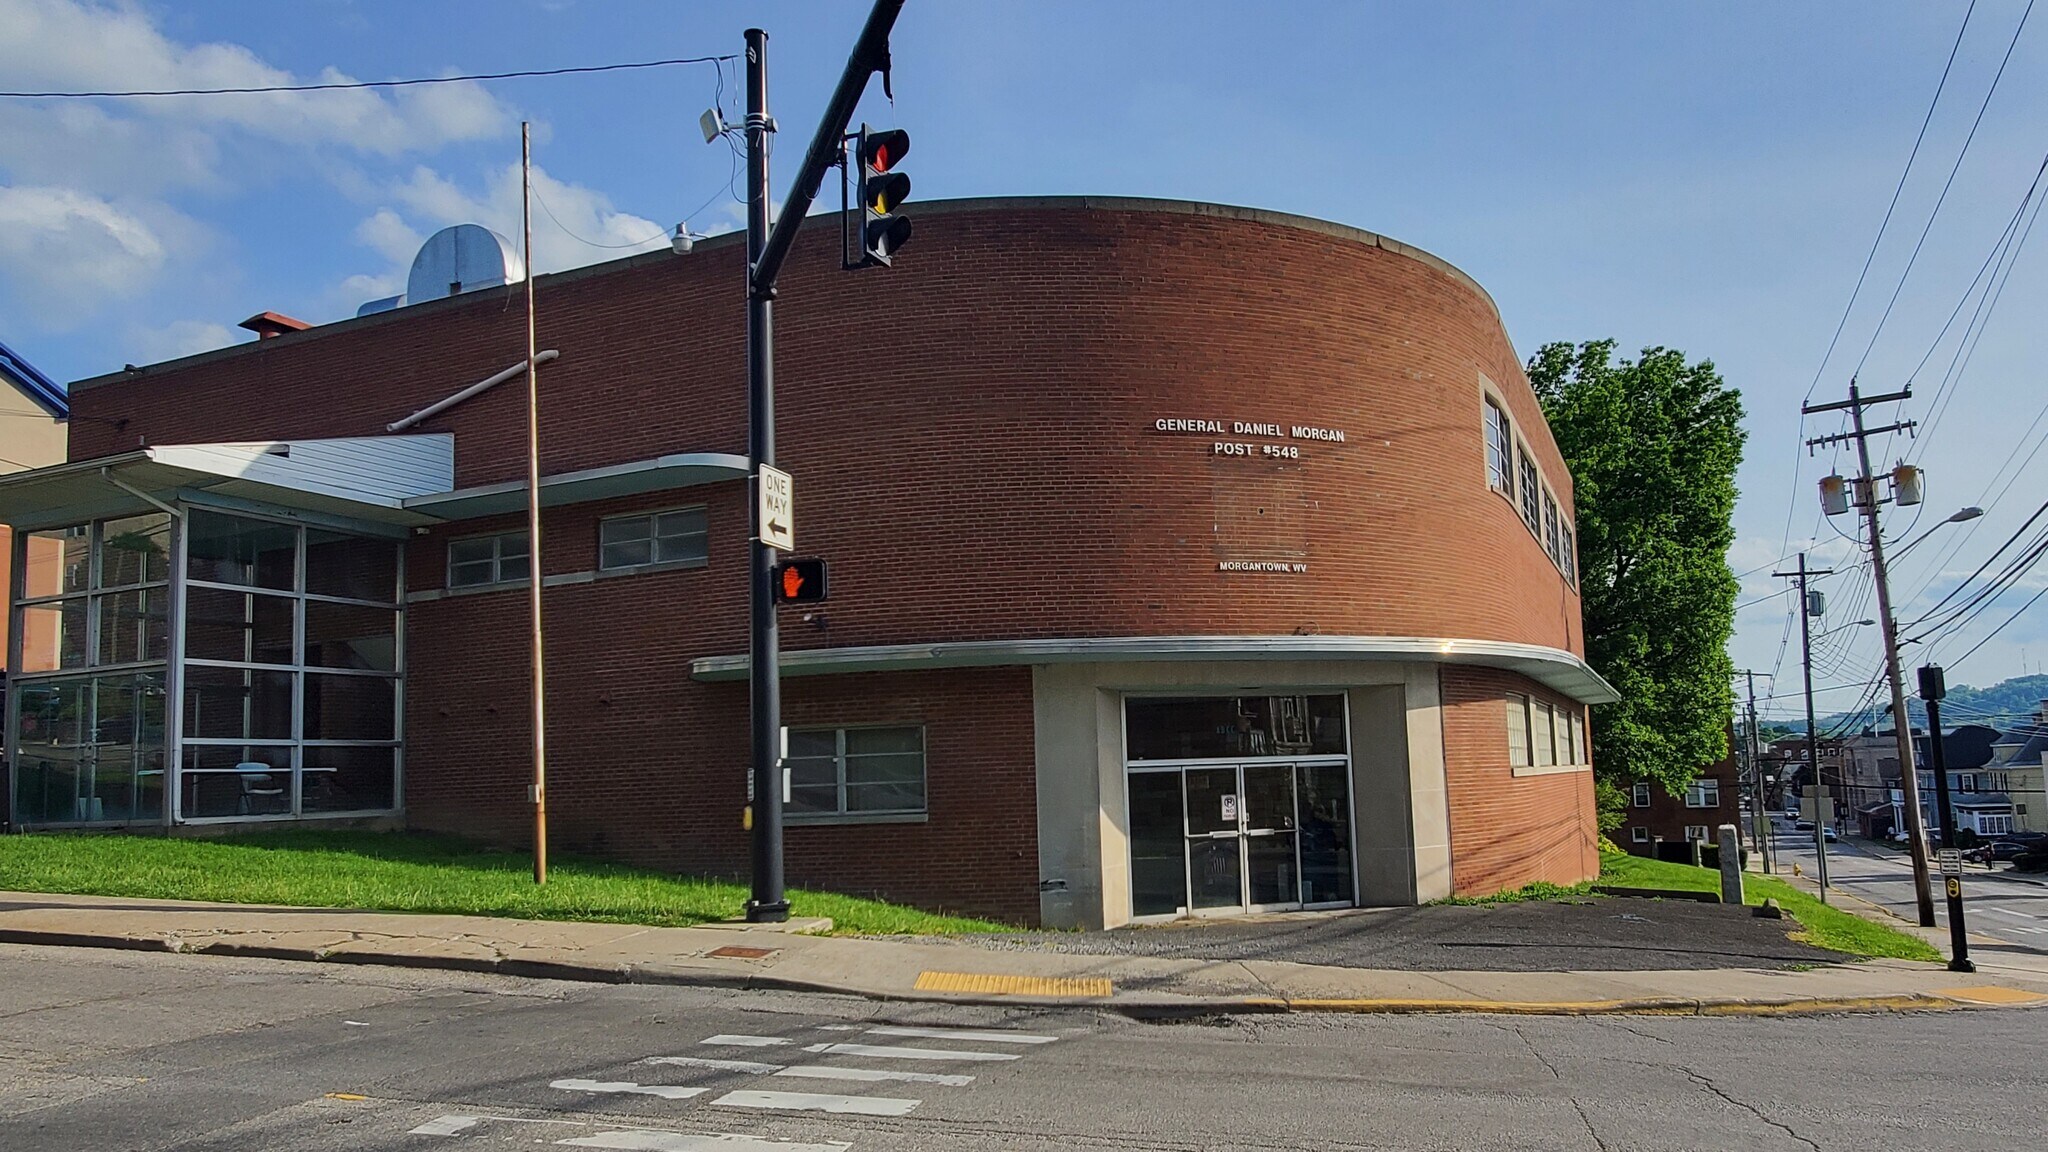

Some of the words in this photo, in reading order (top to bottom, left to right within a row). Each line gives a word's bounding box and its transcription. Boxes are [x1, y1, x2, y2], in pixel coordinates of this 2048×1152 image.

[1155, 418, 1225, 433] GENERAL
[1234, 421, 1284, 437] DANIEL
[1291, 425, 1345, 442] MORGAN
[1214, 442, 1254, 456] POST
[1263, 444, 1299, 459] #548
[766, 474, 787, 495] ONE
[765, 493, 787, 515] WAY
[1219, 561, 1291, 573] MORGANTOWN,
[1293, 563, 1307, 573] WV
